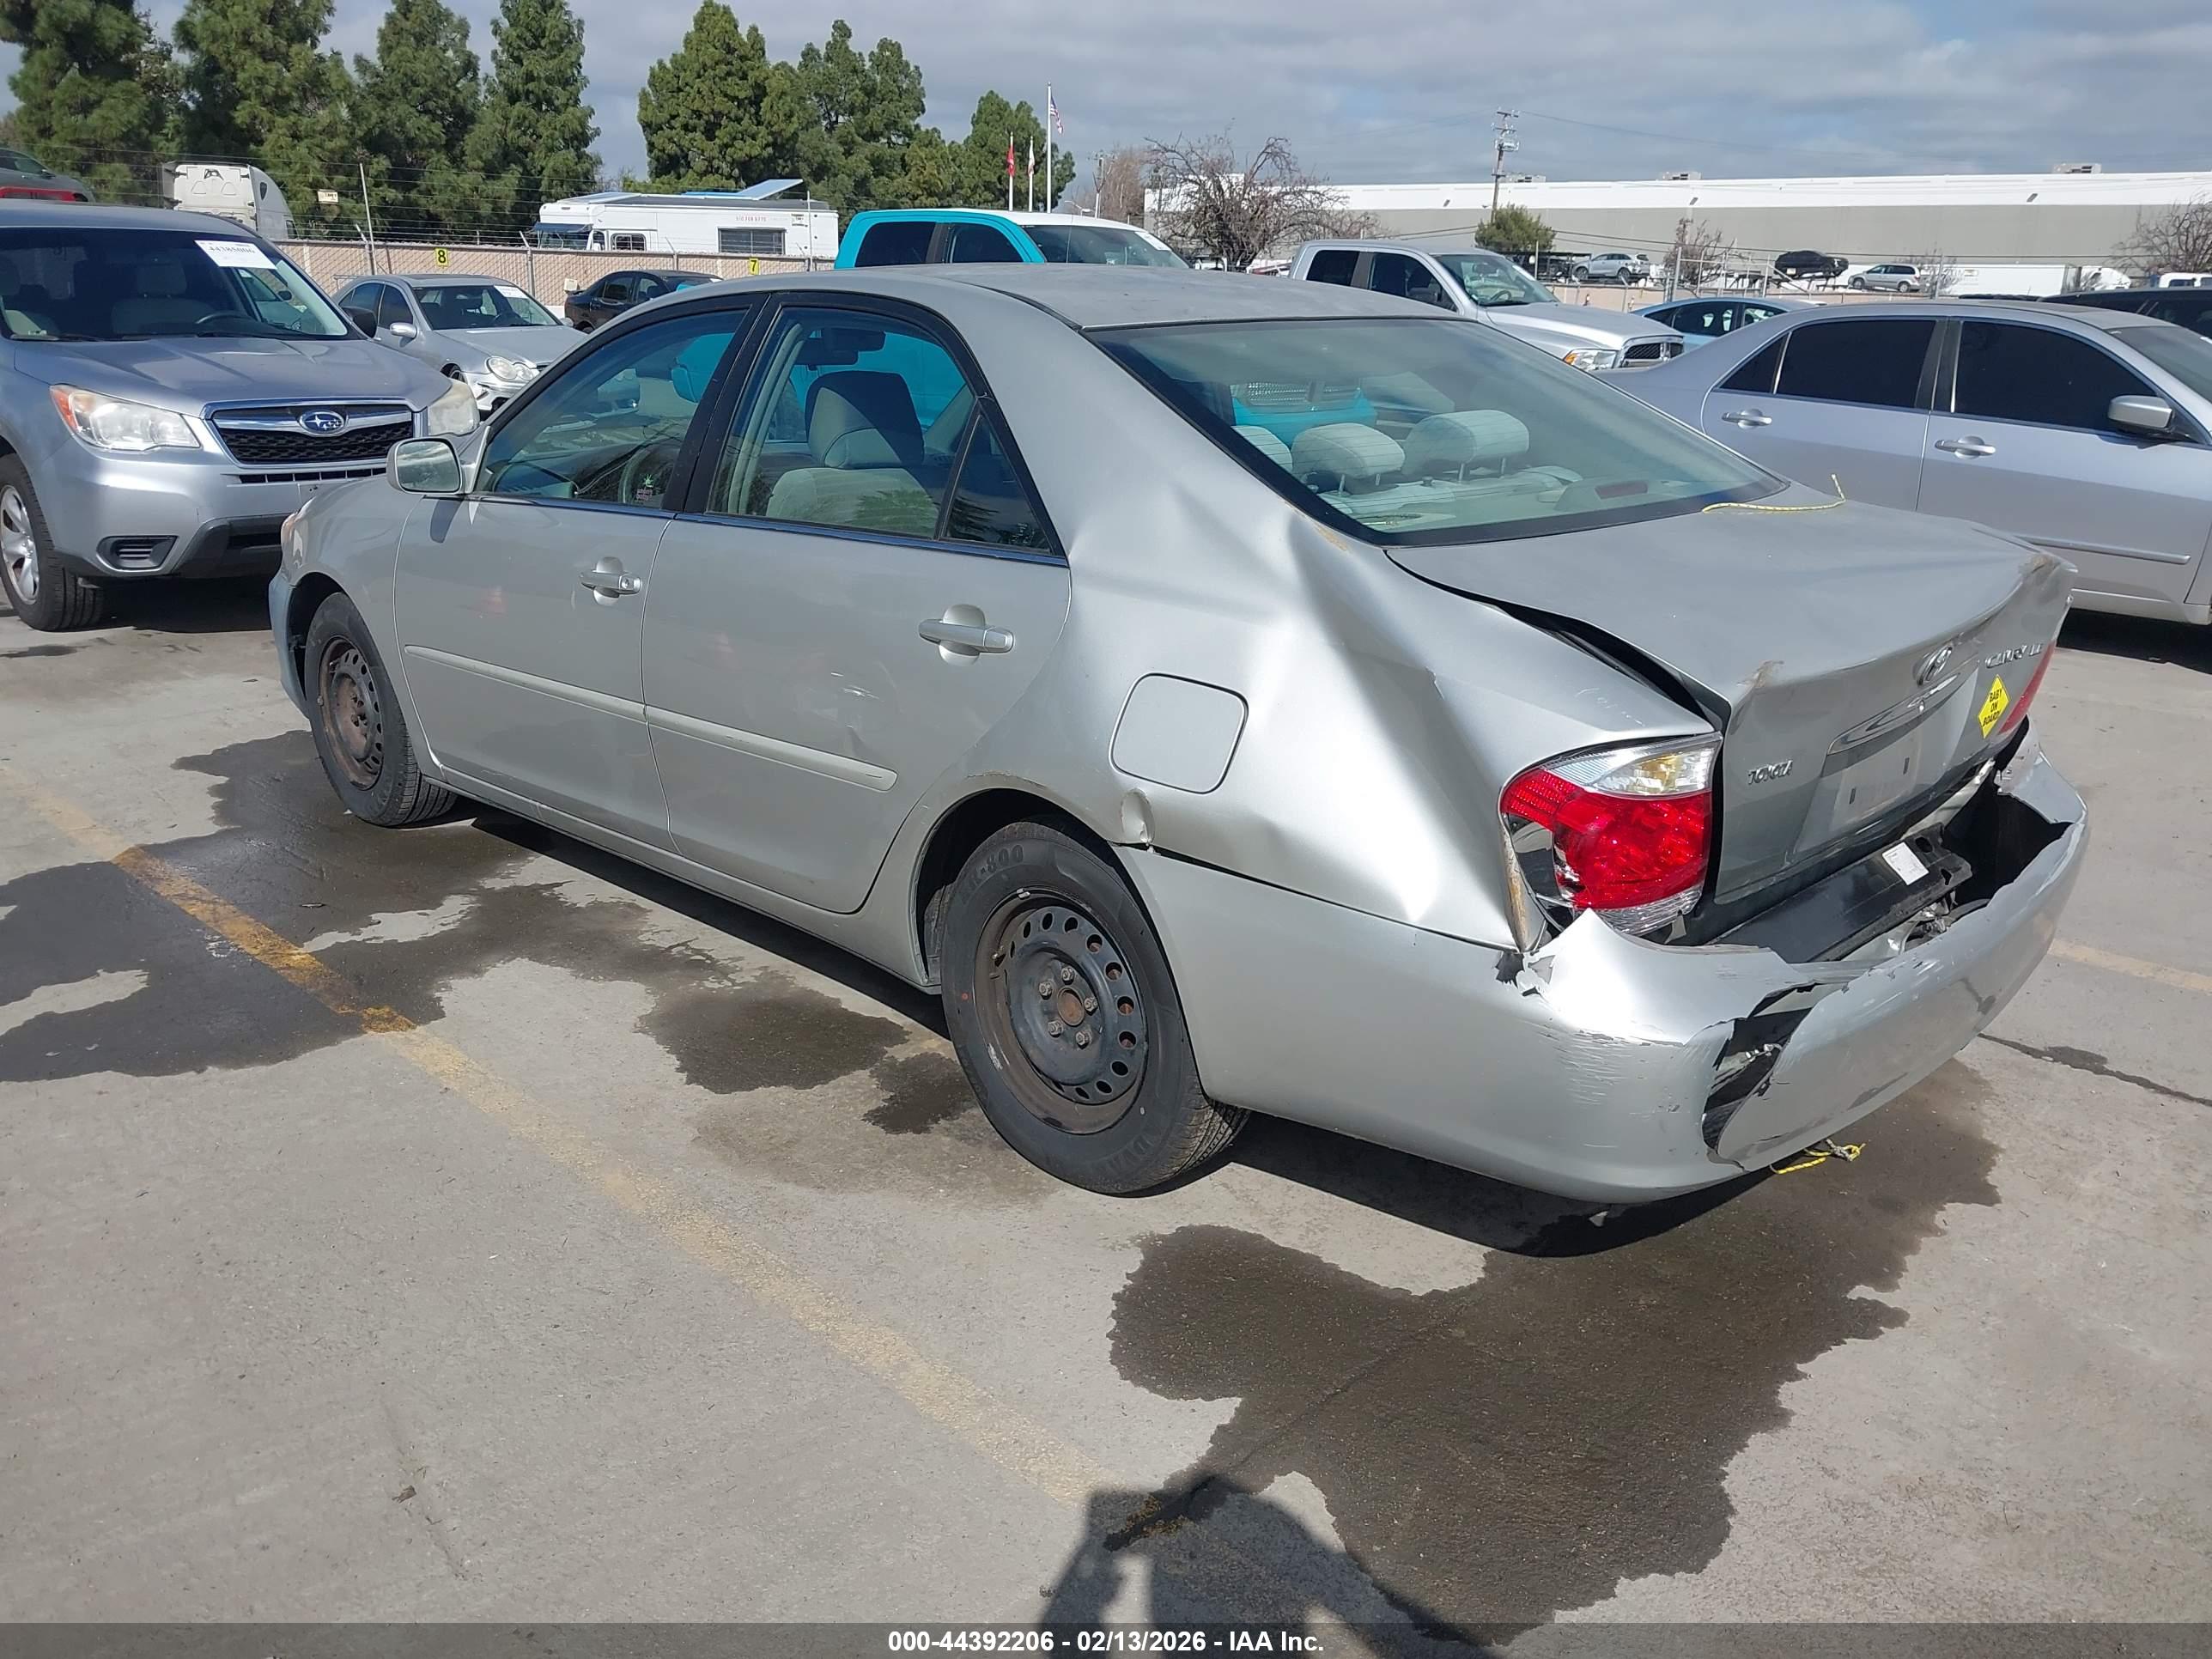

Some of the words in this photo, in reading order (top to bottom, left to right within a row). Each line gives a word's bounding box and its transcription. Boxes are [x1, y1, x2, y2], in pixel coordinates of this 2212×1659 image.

[438, 249, 447, 264] 8
[750, 259, 757, 272] 7
[1990, 689, 2002, 702] BABY
[1990, 702, 1998, 713] ON
[1747, 759, 1794, 786] TOYOTA
